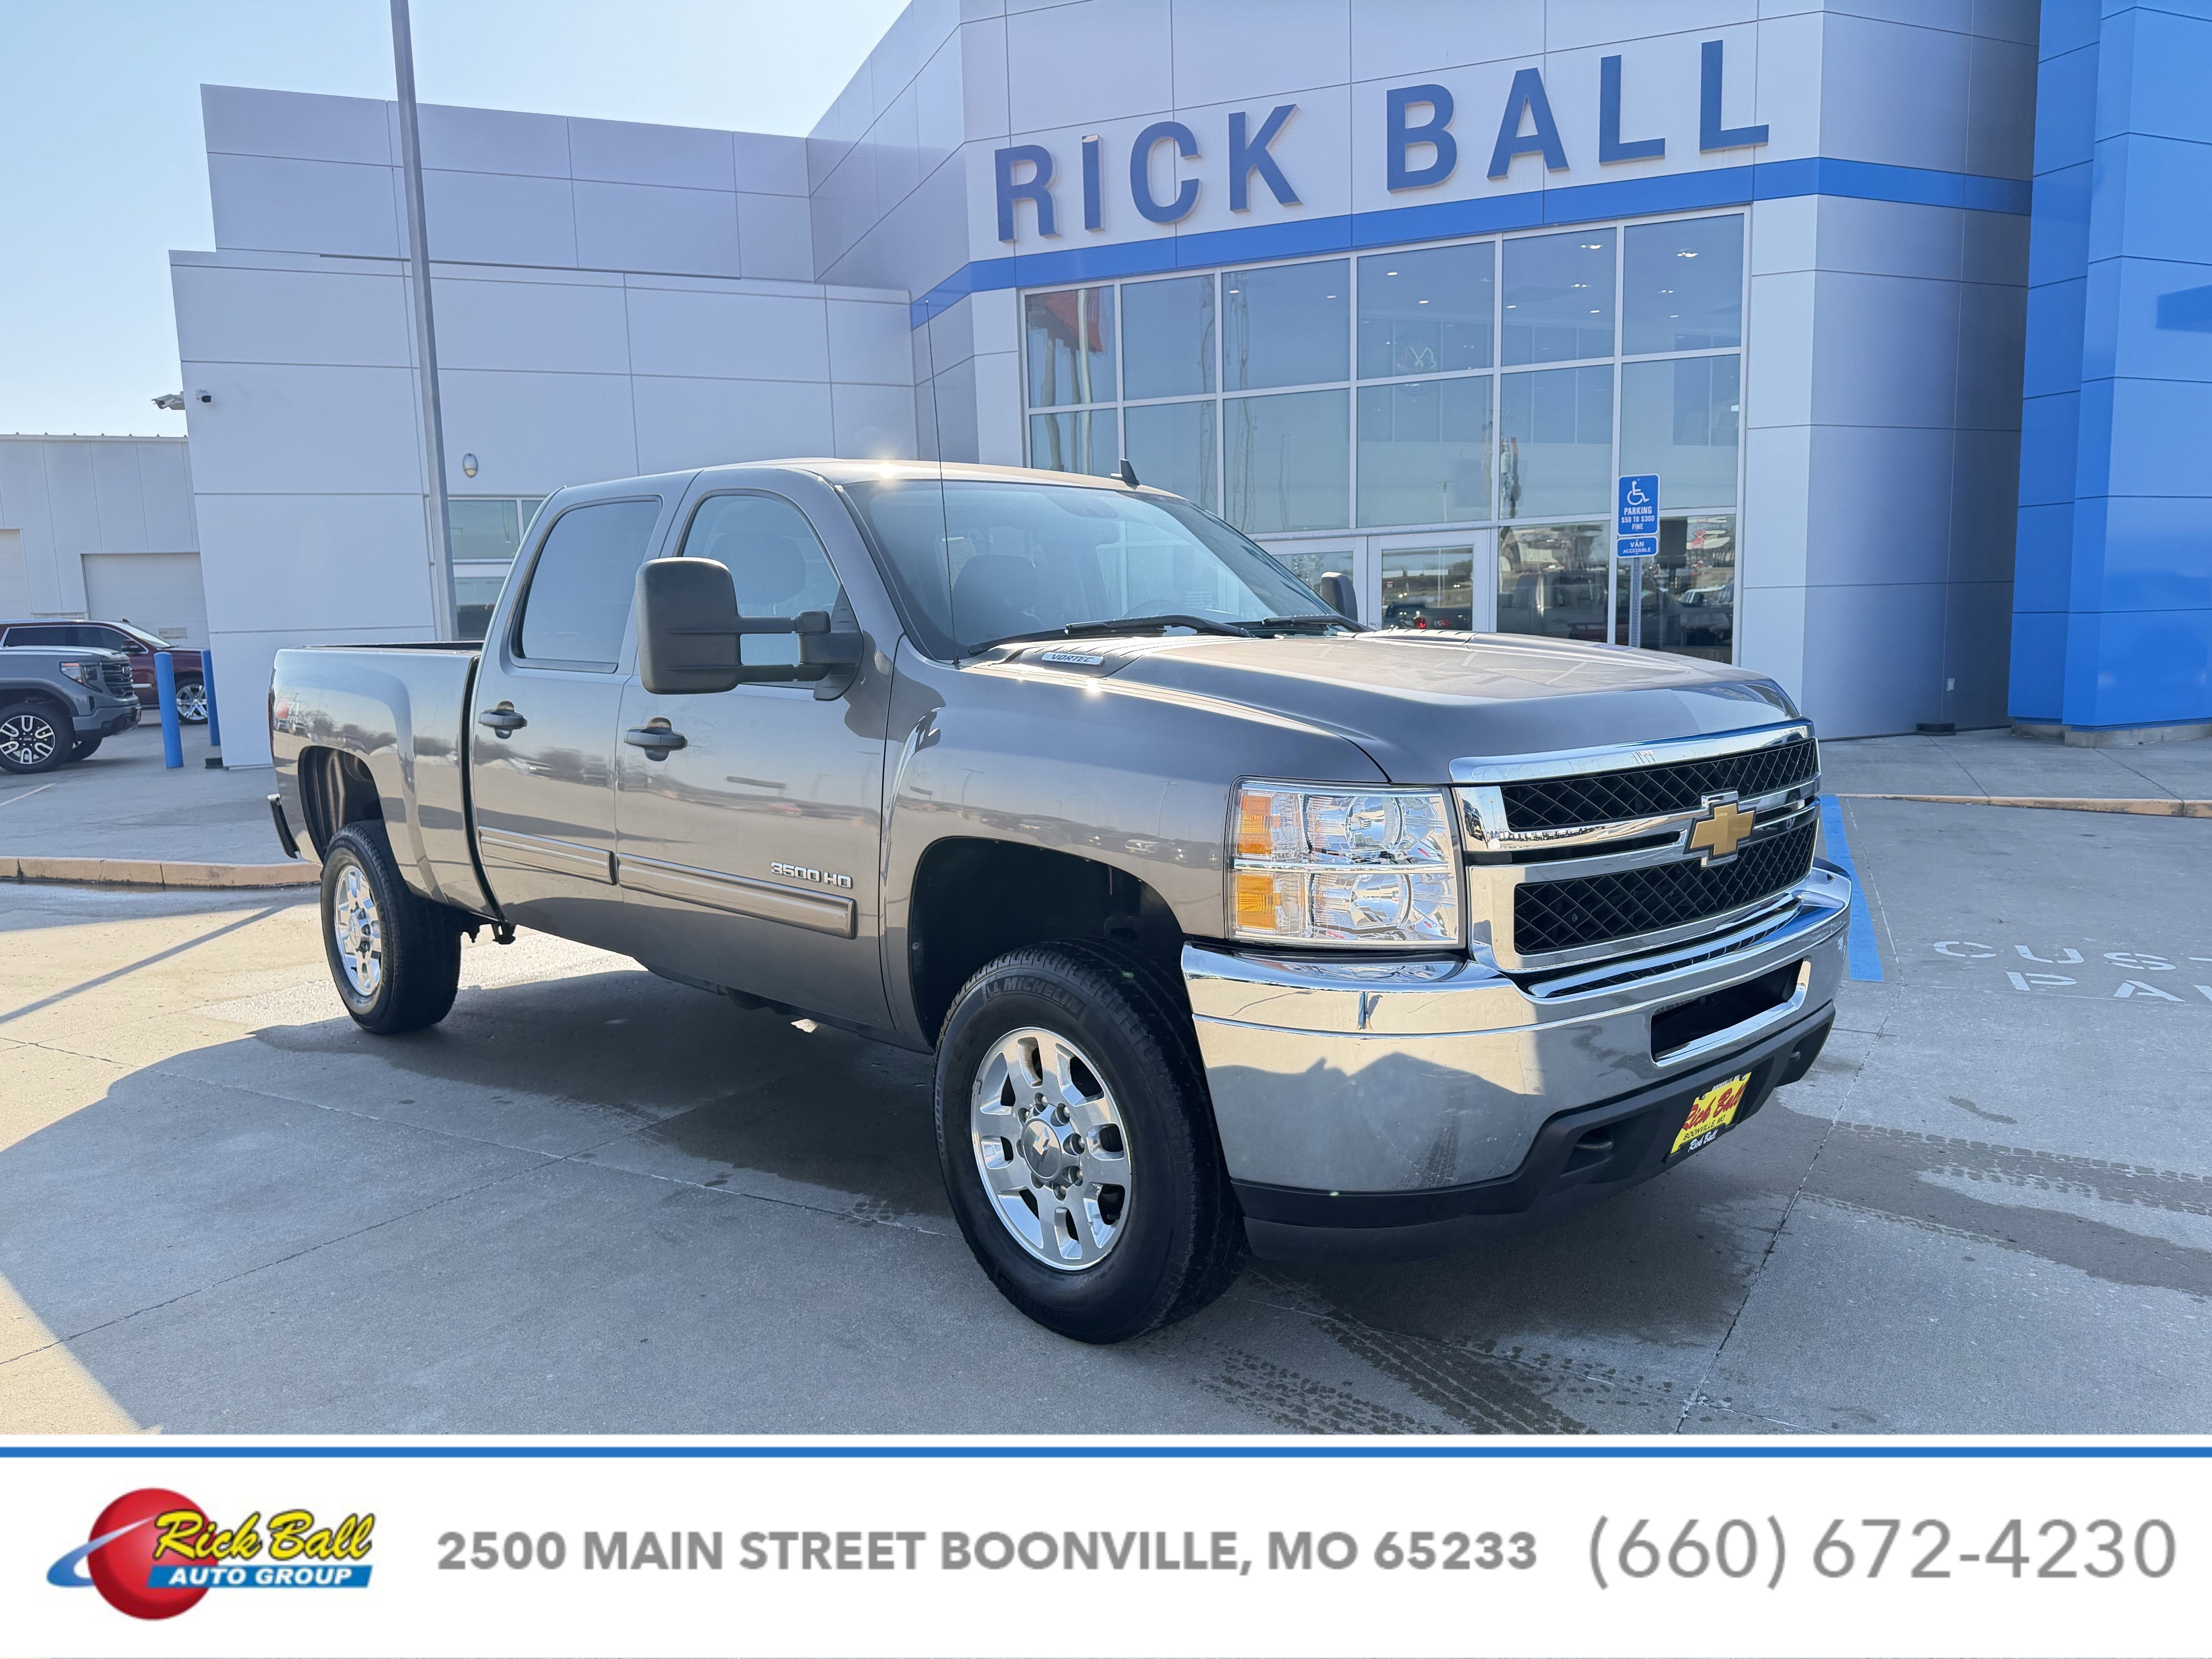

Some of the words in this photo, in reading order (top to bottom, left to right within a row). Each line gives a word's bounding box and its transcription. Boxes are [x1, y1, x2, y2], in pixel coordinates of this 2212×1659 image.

[994, 104, 1303, 244] RICK
[1386, 39, 1769, 194] BALL
[1624, 506, 1652, 515] PARKING
[1052, 654, 1094, 662] VORTEC
[771, 861, 822, 883] 3500
[824, 872, 853, 889] HD
[1003, 977, 1083, 1013] MICHELIN
[1682, 1096, 1717, 1131] Rick
[1713, 1078, 1748, 1118] Ball
[1683, 1123, 1716, 1140] BOONVILLE,
[1716, 1115, 1726, 1125] MO
[1688, 1135, 1704, 1152] Rick
[1703, 1128, 1719, 1144] Ball
